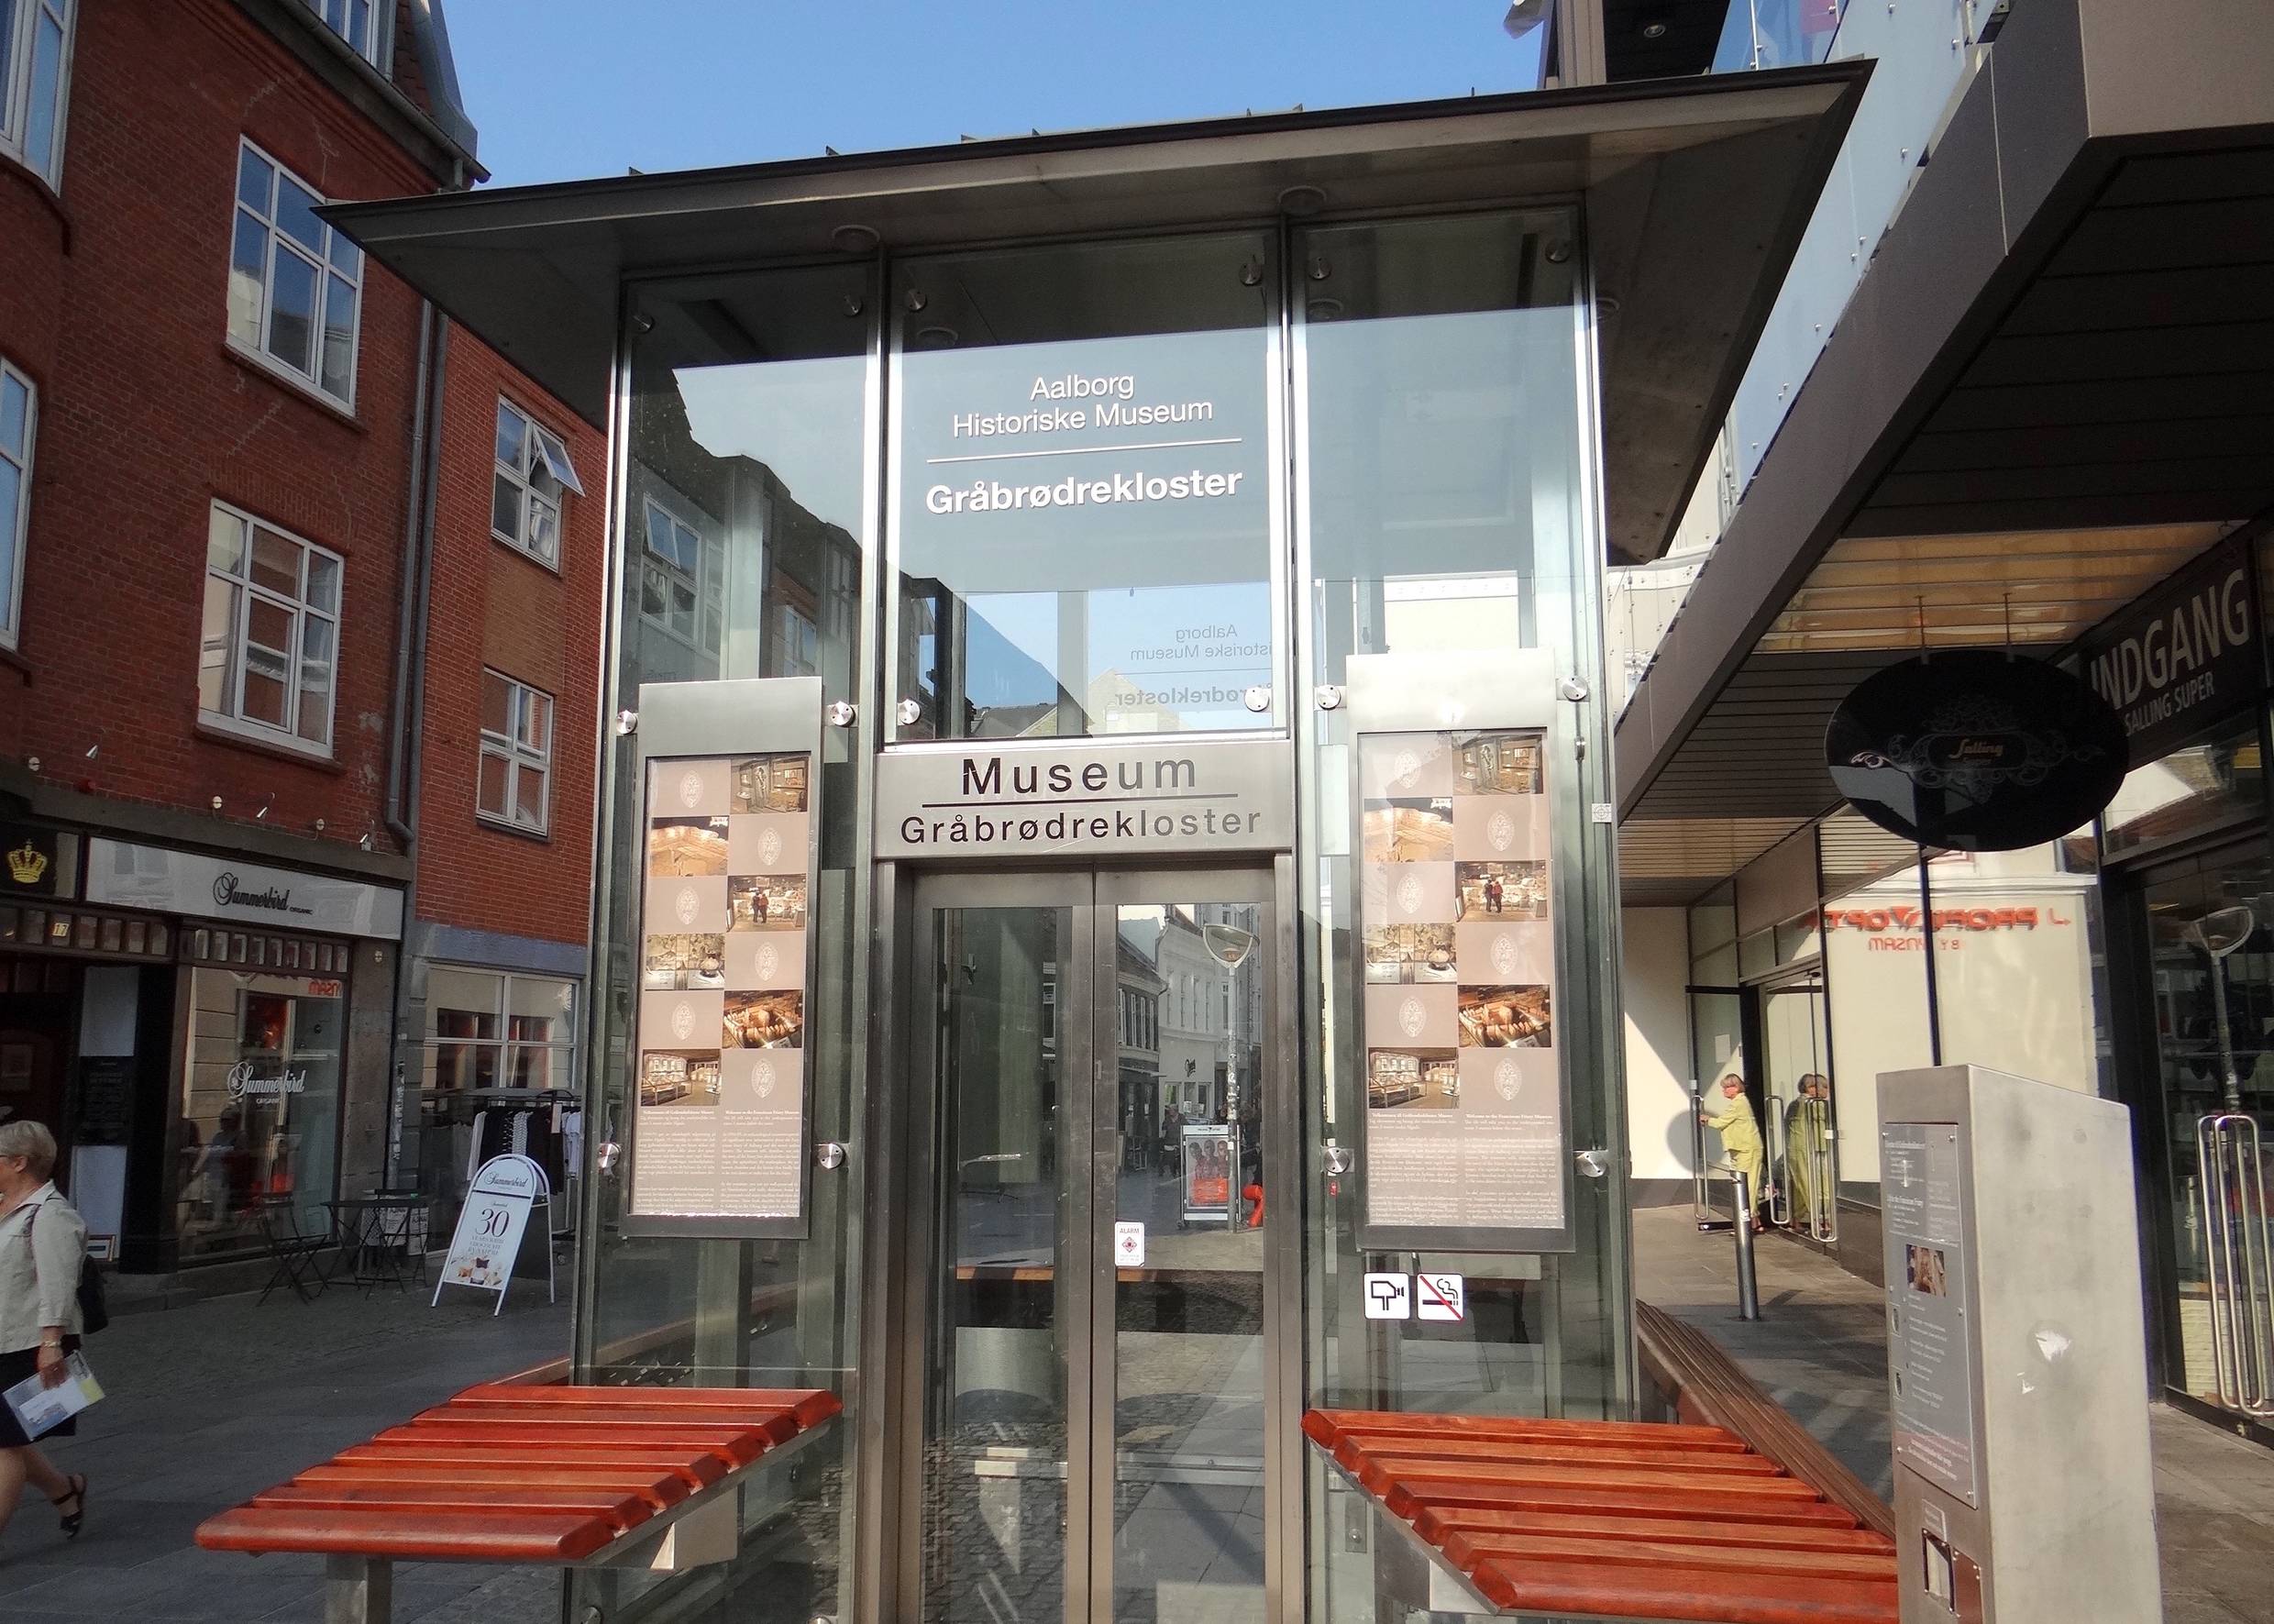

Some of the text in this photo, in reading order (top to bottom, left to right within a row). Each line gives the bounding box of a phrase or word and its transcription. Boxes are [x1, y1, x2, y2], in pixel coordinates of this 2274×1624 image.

[1030, 373, 1135, 402] Aalborg
[953, 399, 1214, 438] Historiske Museum
[925, 469, 1243, 515] Gråbrødrekloster
[2090, 569, 2250, 711] INDGANG
[2124, 671, 2215, 738] SALLING SUPER
[962, 757, 1197, 797] Museum
[900, 807, 1262, 845] Gråbrødrekloster
[213, 871, 291, 911] Summerbird
[52, 922, 70, 937] 17
[227, 1061, 307, 1099] Summerbird
[483, 1171, 528, 1188] Summerbird
[475, 1208, 510, 1238] 30
